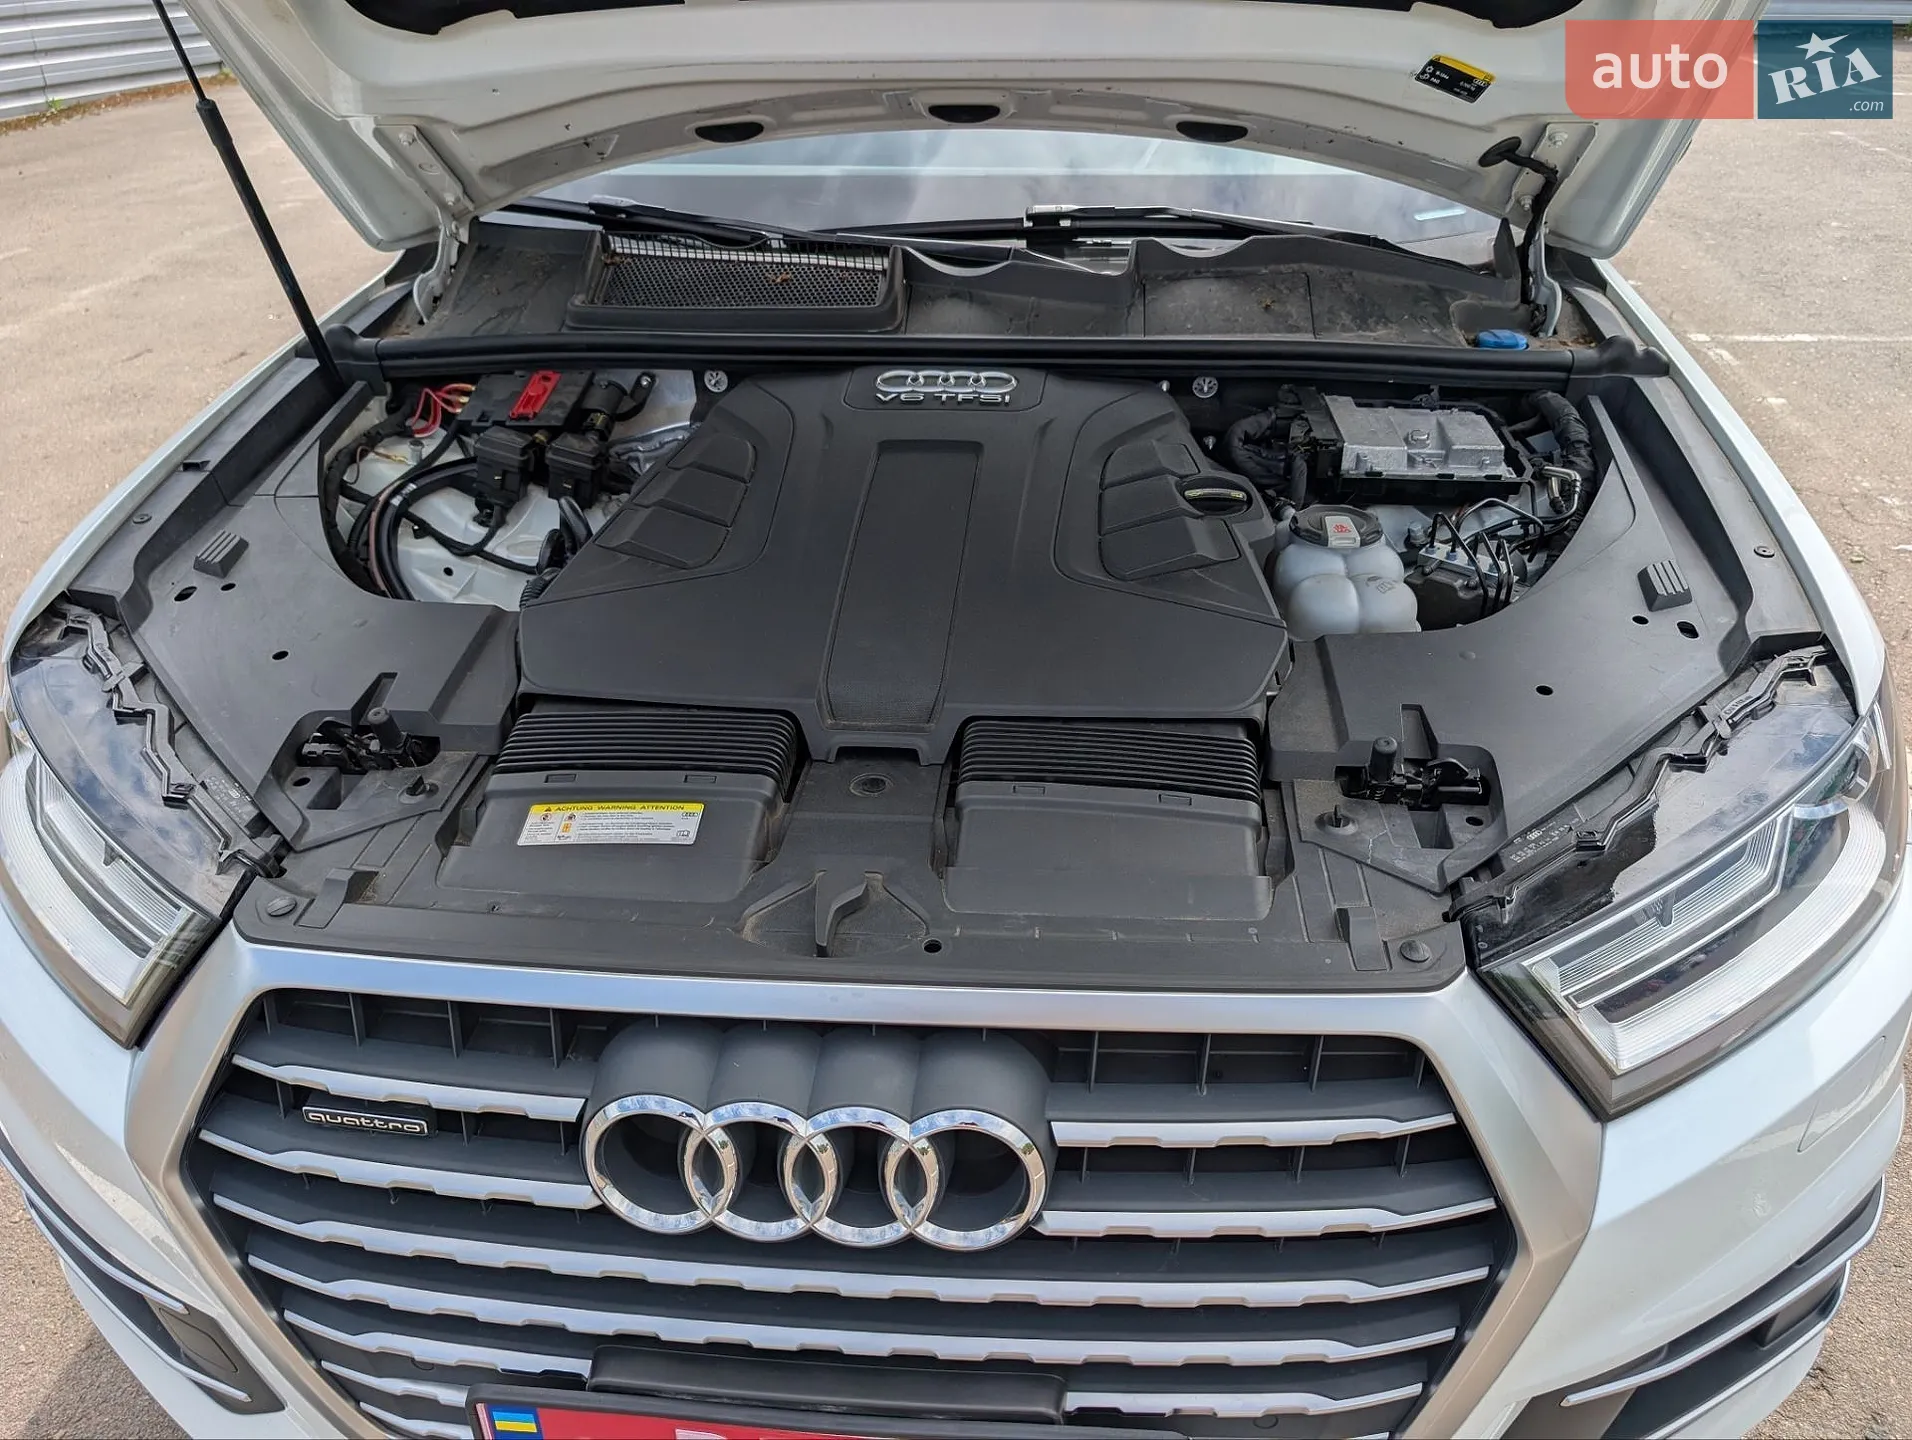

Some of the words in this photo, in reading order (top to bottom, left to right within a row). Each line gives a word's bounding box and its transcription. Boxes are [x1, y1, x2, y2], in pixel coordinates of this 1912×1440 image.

[875, 393, 925, 402] V6
[933, 393, 1011, 403] TFSI
[308, 1112, 421, 1132] quattro
